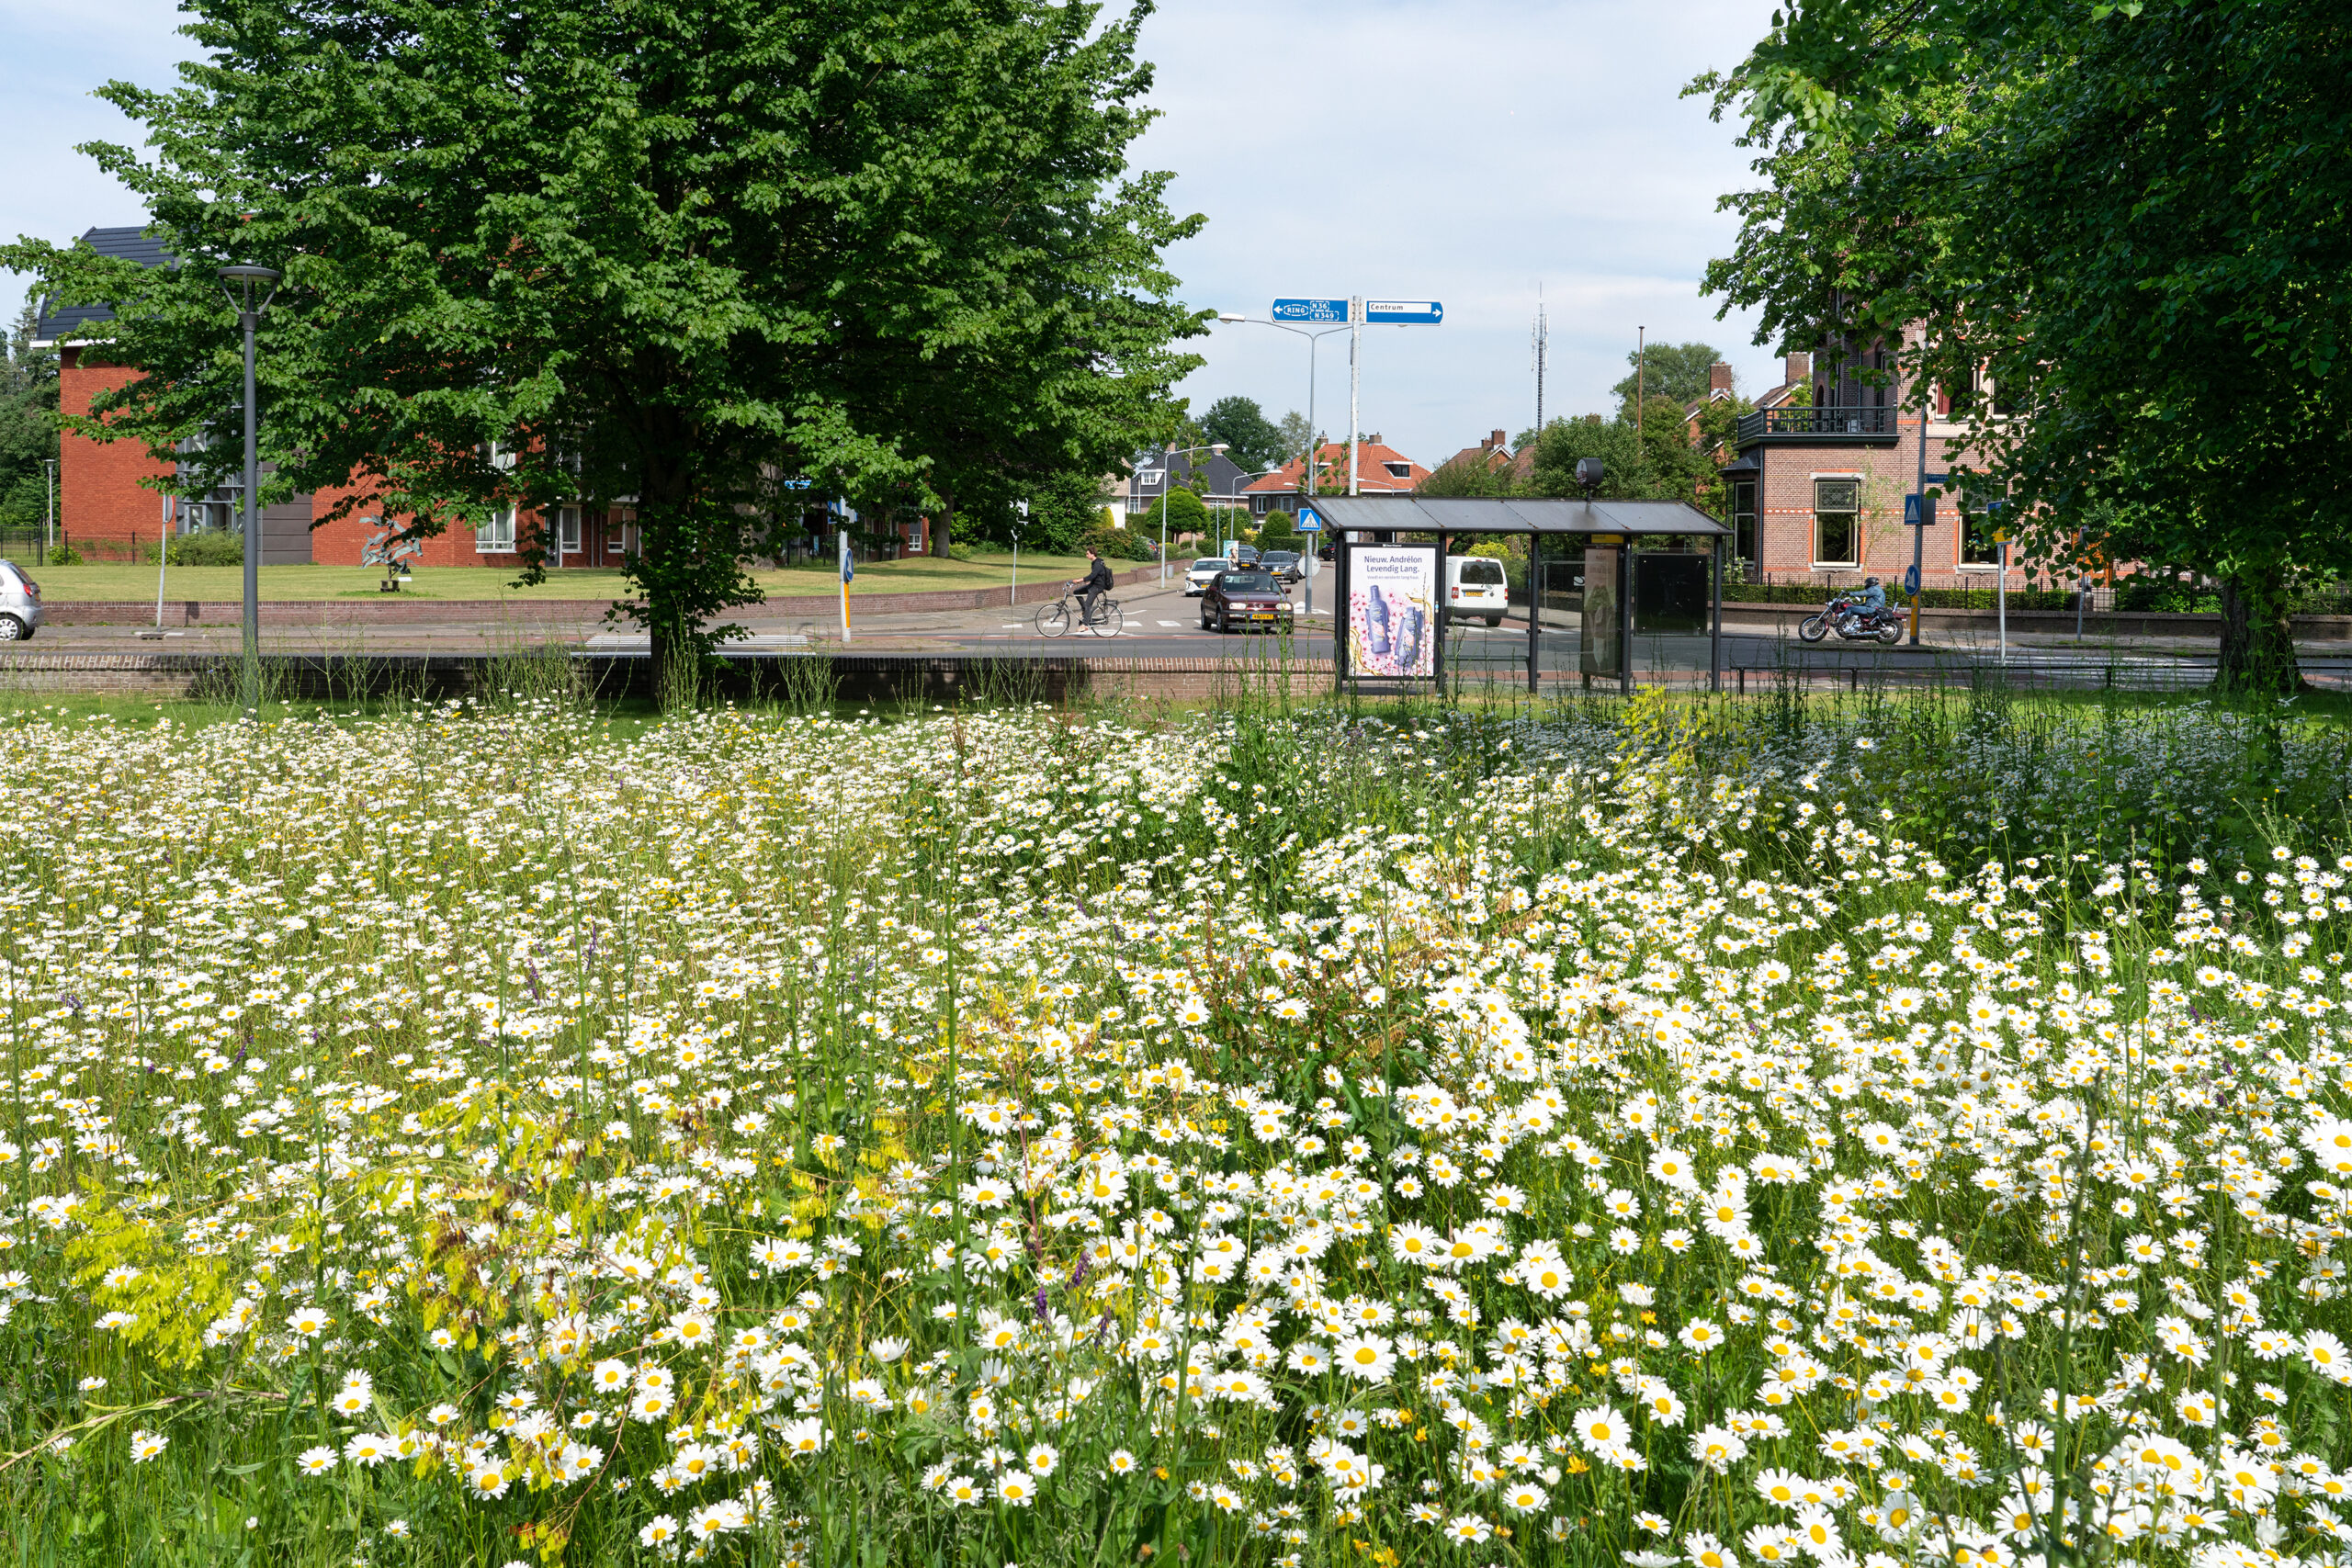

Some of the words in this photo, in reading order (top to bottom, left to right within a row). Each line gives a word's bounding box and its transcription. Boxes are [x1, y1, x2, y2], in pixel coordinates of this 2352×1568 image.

[1389, 555, 1422, 563] Andrélon
[1366, 565, 1398, 573] Levendig
[1400, 565, 1419, 573] Lang.
